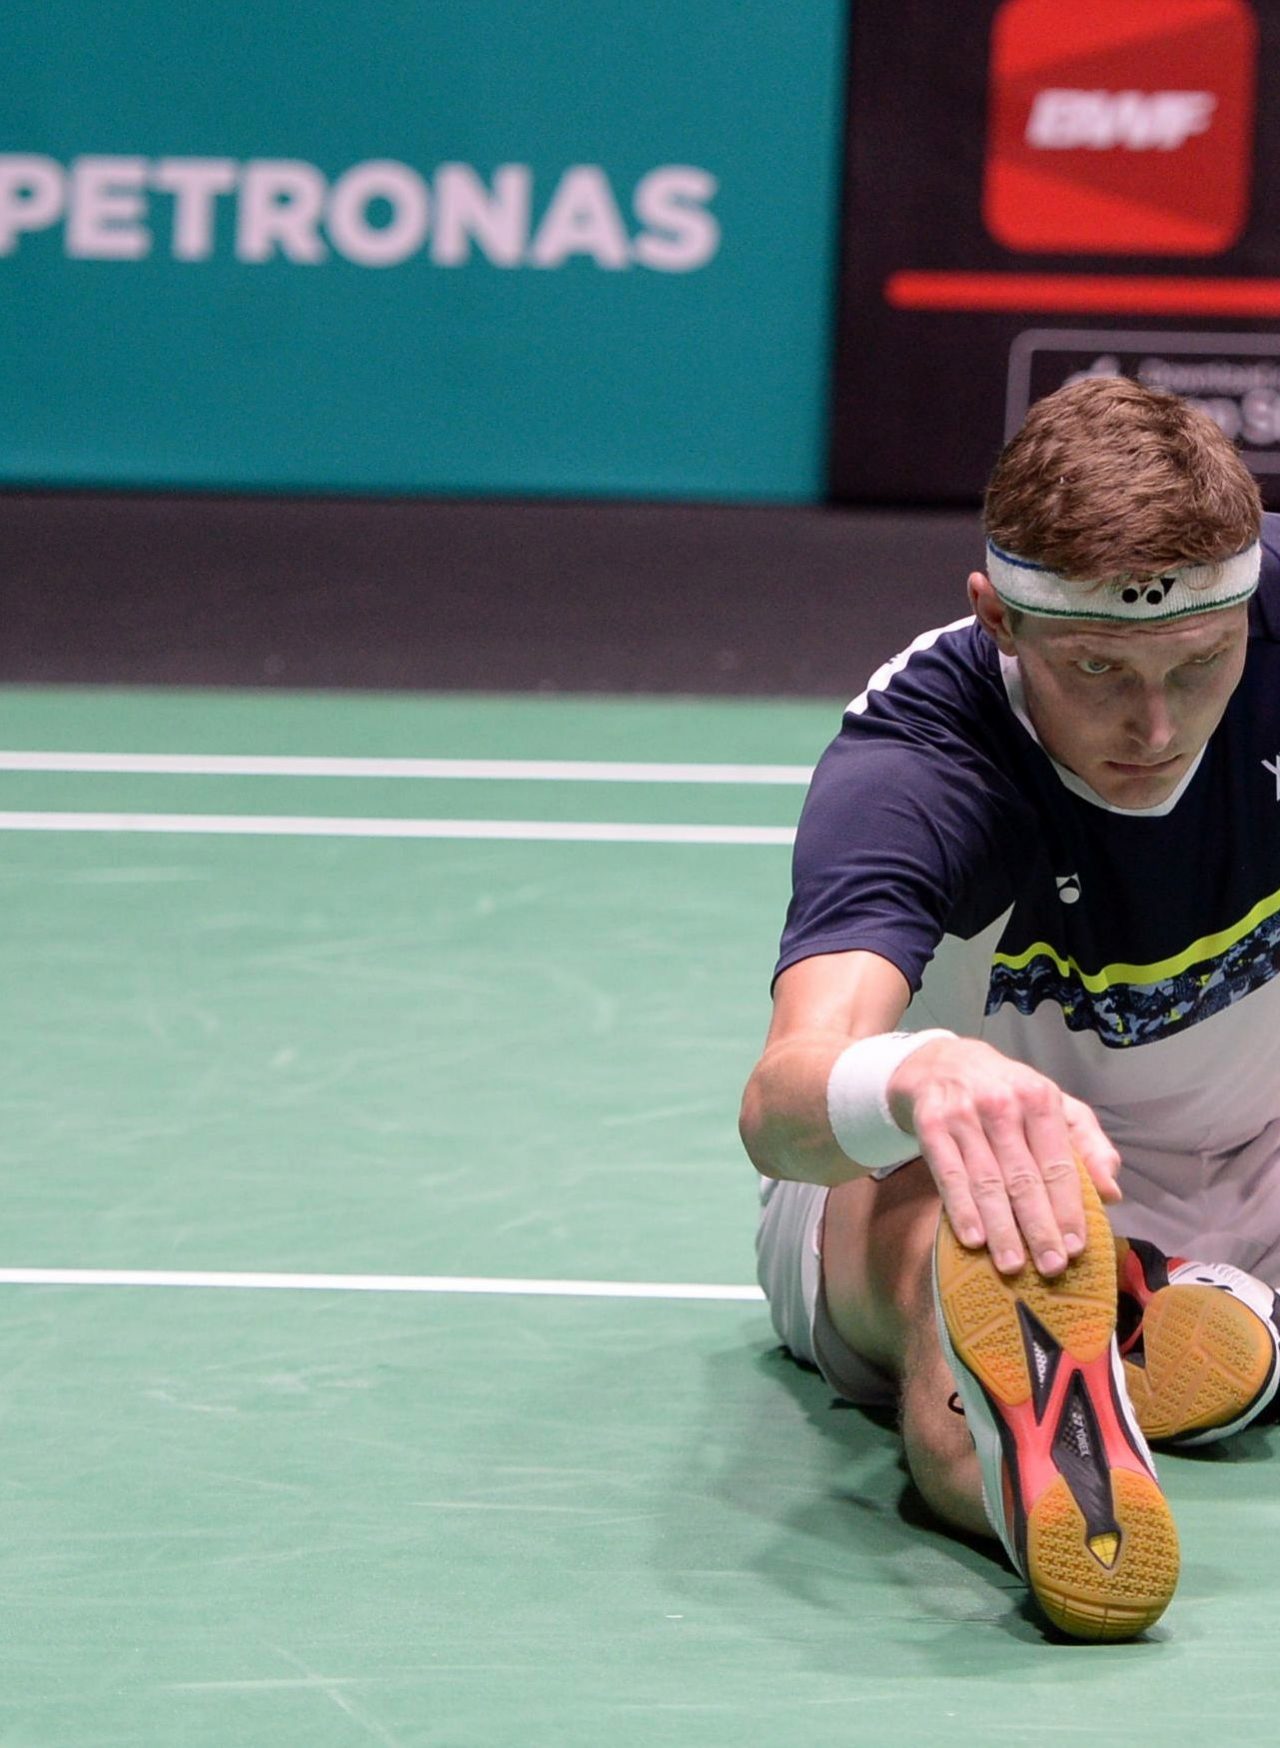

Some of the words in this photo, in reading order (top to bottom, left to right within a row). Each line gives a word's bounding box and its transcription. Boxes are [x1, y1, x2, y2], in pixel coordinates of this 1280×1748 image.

[1027, 89, 1216, 149] BWF
[0, 156, 718, 270] PETRONAS
[1075, 1427, 1090, 1458] YONEX
